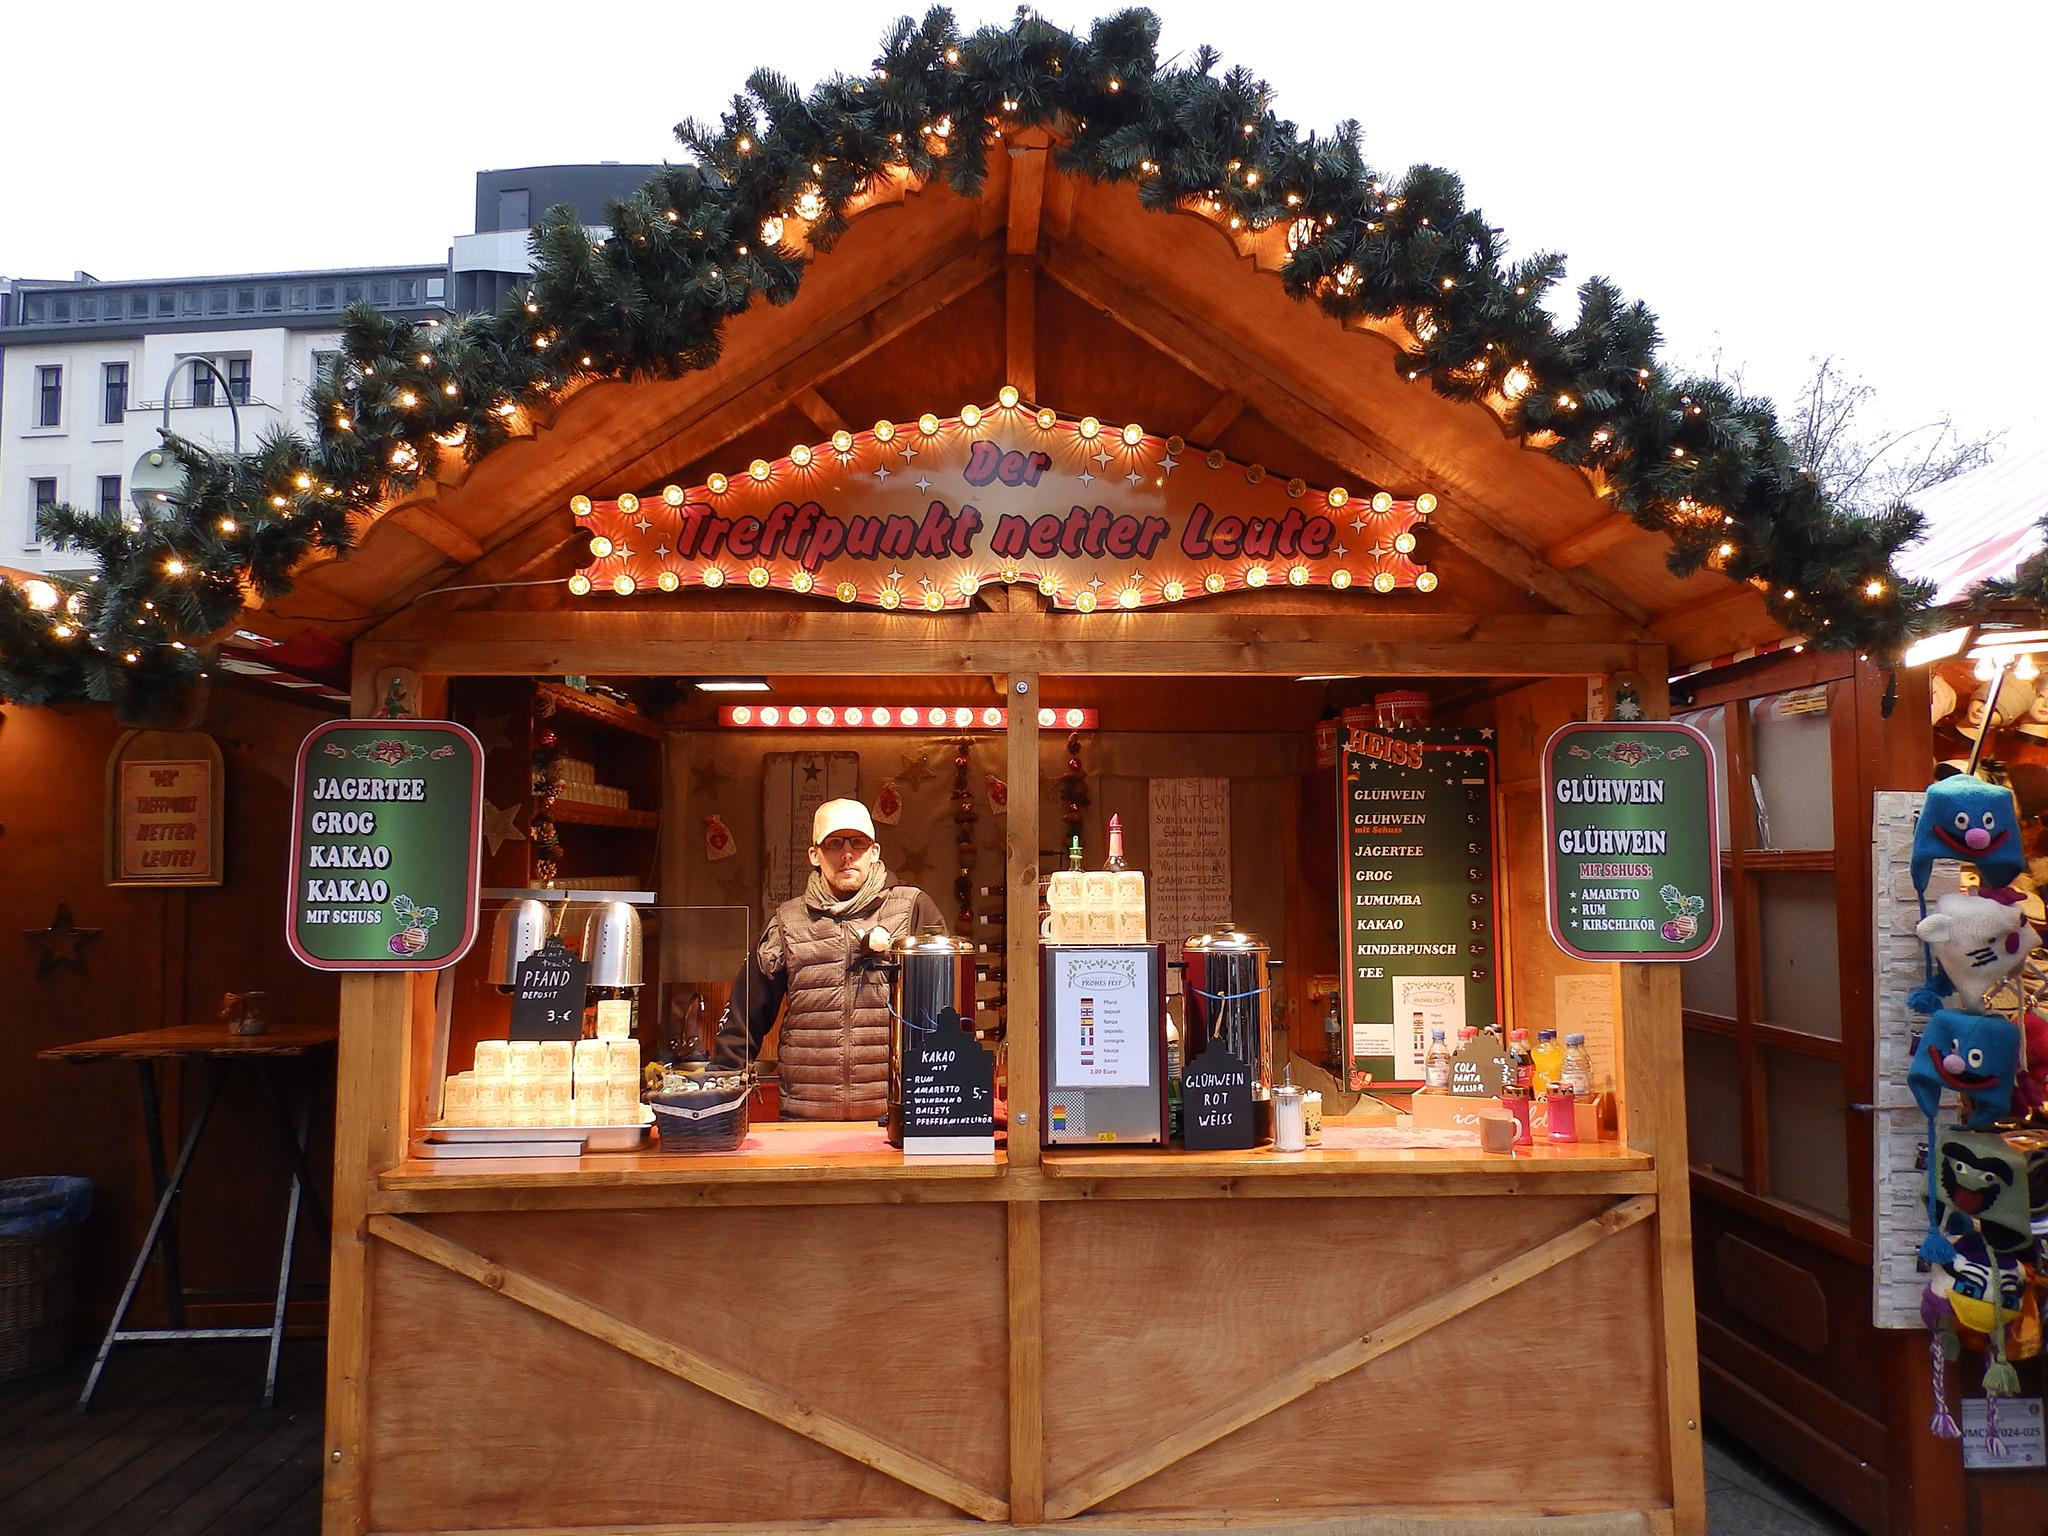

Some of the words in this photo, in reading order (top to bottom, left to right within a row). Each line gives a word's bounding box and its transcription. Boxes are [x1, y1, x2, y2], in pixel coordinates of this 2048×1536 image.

[963, 440, 1052, 487] Der
[676, 501, 983, 573] Treffpunkt
[990, 505, 1170, 560] netter
[1180, 502, 1336, 560] Leute
[1348, 728, 1423, 769] HEISS
[313, 777, 425, 800] JAGERTEE
[1354, 787, 1426, 800] GLÜHWEIN
[1557, 774, 1664, 803] GLÜHWEIN
[1153, 794, 1225, 811] WINTER
[311, 812, 375, 834] GROG
[1354, 811, 1426, 825] GLÜHWEIN
[1354, 826, 1370, 834] mit
[1372, 826, 1403, 834] Schuss
[1558, 825, 1666, 854] GLÜHWEIN
[1355, 843, 1424, 857] JÄGERTEE
[309, 846, 390, 868] KAKAO
[1355, 870, 1393, 881] GROG
[1580, 863, 1602, 877] MIT
[1603, 863, 1653, 877] SCHUSS:
[307, 880, 388, 901] KAKAO
[1581, 888, 1640, 900] AMARETTO
[1356, 895, 1422, 906] LUMUMBA
[1582, 904, 1606, 915] RUM
[306, 910, 331, 923] MIT
[332, 910, 382, 923] SCHUSS
[1356, 919, 1404, 930] KAKAO
[1357, 944, 1457, 955] KINDERPUNSCH
[523, 970, 571, 987] PFAND
[1358, 967, 1384, 978] TEE
[522, 991, 558, 999] DEPOSIT
[921, 1050, 955, 1063] KAKAO
[1454, 1062, 1477, 1073] COLA
[914, 1075, 934, 1083] RUM
[1453, 1074, 1481, 1083] FANTA
[914, 1086, 960, 1094] AMARETTO
[1452, 1083, 1485, 1093] WASSER
[1204, 1092, 1228, 1106] ROT
[915, 1106, 951, 1115] BAILEYS
[1198, 1112, 1233, 1127] WEISS
